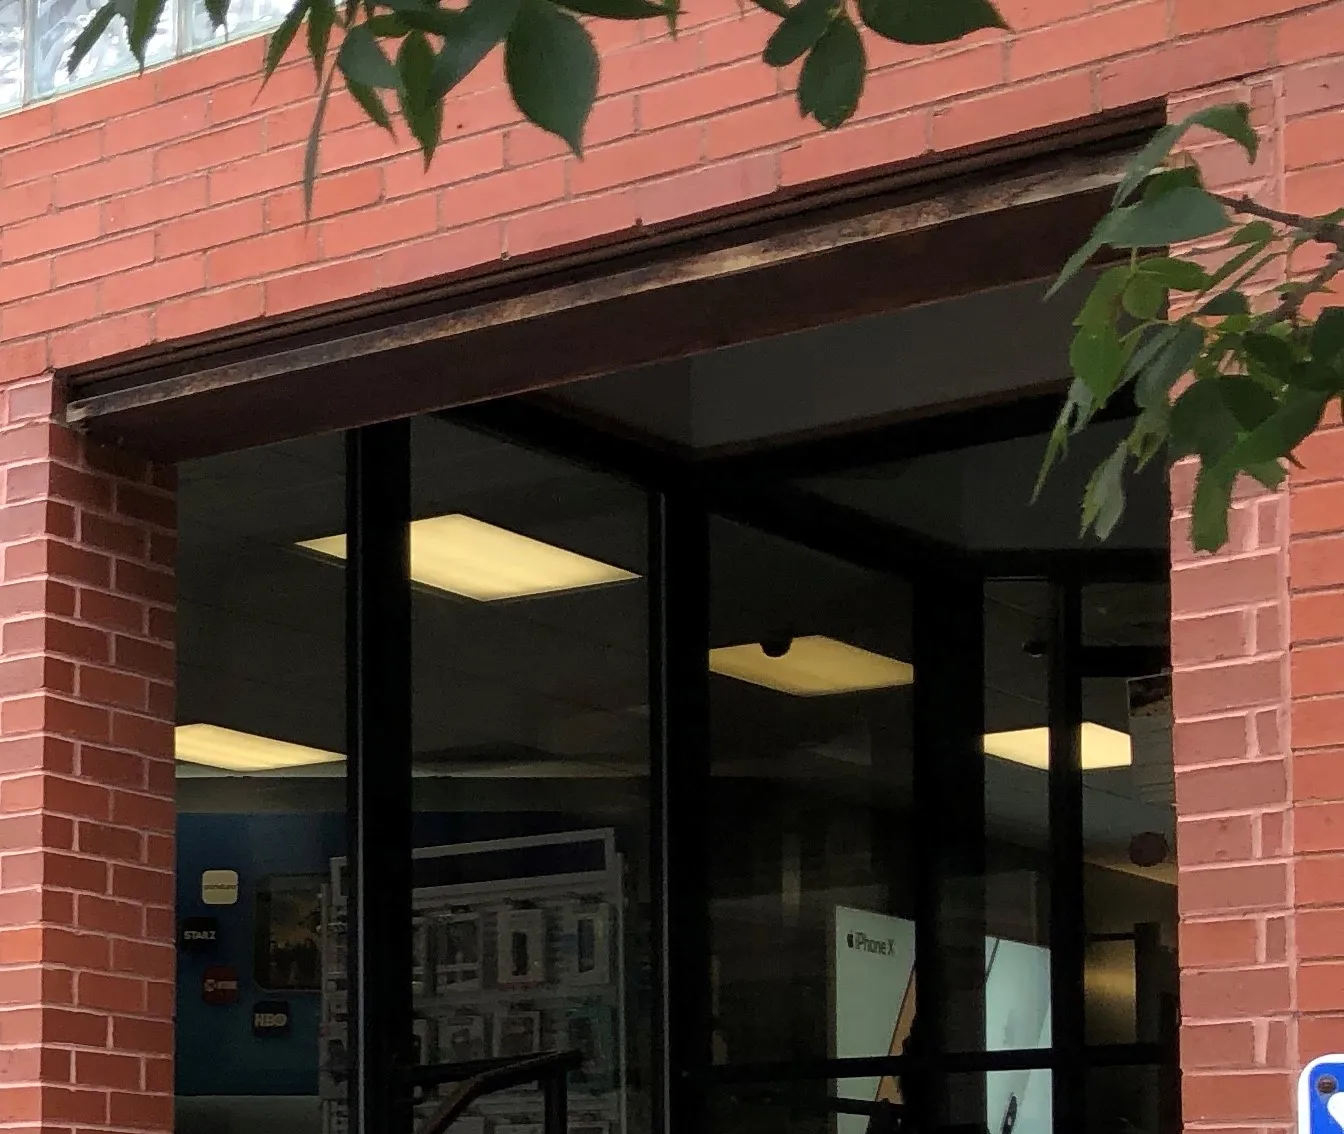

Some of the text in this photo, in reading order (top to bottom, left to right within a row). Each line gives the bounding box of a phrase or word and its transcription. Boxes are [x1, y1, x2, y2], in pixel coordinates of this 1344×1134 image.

[183, 930, 217, 941] STARZ
[854, 931, 896, 956] iPhone X
[254, 1012, 288, 1028] HBO
